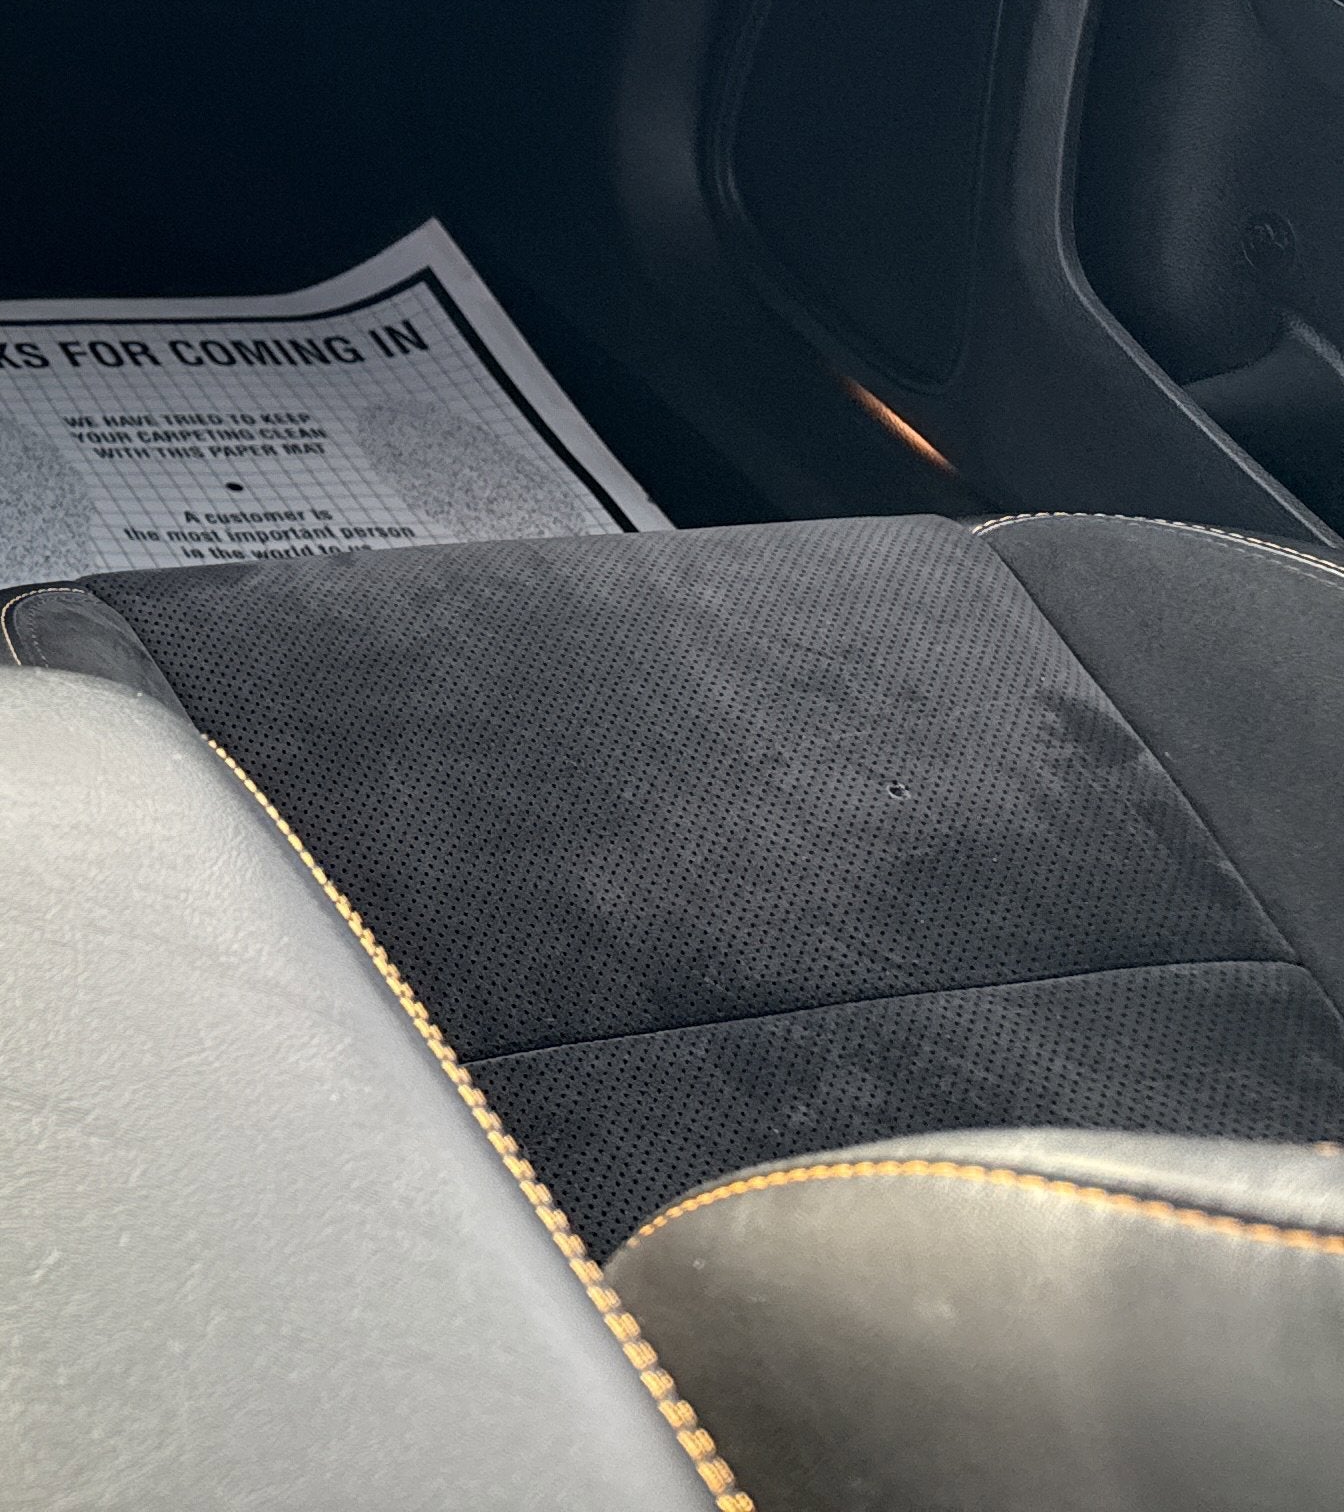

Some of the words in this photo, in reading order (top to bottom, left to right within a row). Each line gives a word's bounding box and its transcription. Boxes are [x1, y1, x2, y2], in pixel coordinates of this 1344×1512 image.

[57, 339, 161, 369] FOR
[168, 334, 366, 367] COMING
[367, 318, 430, 358] IN
[63, 415, 97, 428] WE
[101, 414, 158, 428] HAVE
[162, 413, 224, 427] TRIED
[226, 413, 257, 426] TO
[260, 412, 312, 425] KEEP
[69, 430, 132, 444] YOUR
[135, 428, 256, 444] CARPETING
[258, 427, 328, 440] CLEAN
[92, 446, 152, 460] WITH
[157, 445, 206, 459] THIS
[207, 444, 280, 458] PAPER
[281, 442, 328, 456] MAT
[182, 510, 201, 524] A
[203, 509, 307, 525] customer
[310, 508, 334, 521] is
[123, 526, 160, 542] the
[165, 528, 220, 544] most
[224, 524, 335, 545] important
[339, 525, 417, 540] person
[180, 544, 205, 560] in
[210, 543, 247, 560] the
